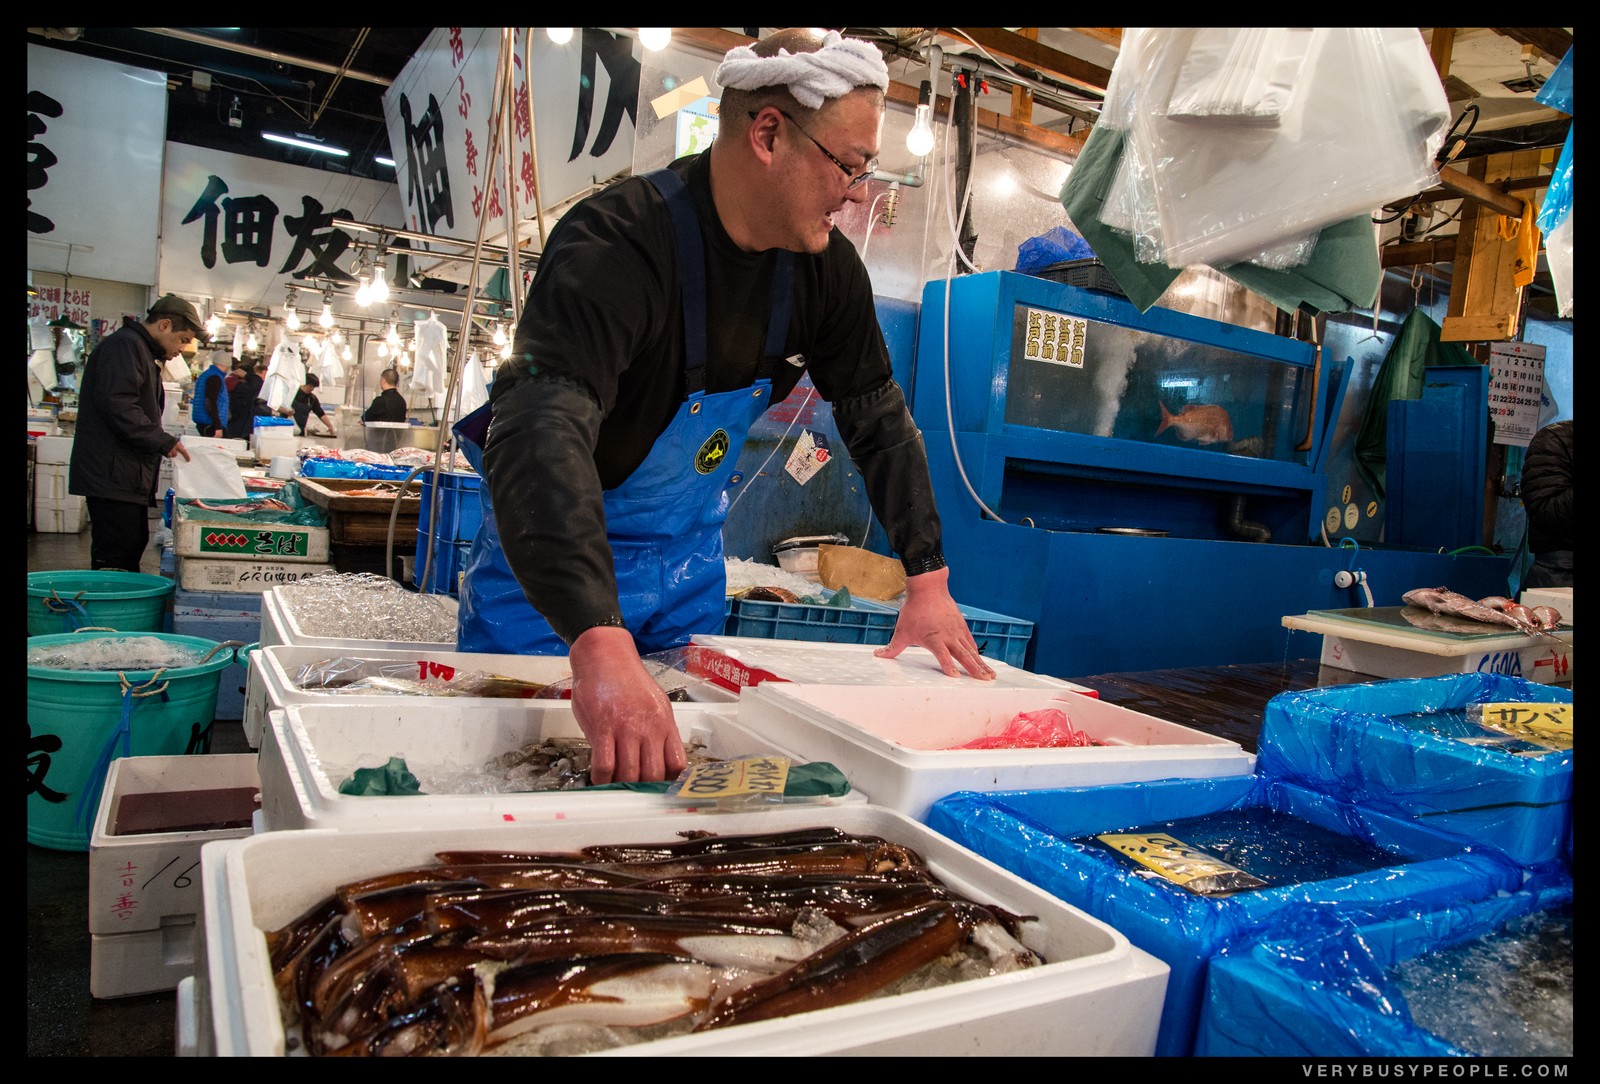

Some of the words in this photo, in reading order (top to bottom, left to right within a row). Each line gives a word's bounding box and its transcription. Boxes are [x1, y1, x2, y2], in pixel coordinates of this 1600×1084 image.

[1026, 311, 1042, 357] 江戸前
[1041, 314, 1057, 360] 江戸前
[1055, 317, 1071, 362] 江戸前
[1070, 320, 1085, 365] 江戸前
[1497, 368, 1502, 376] 7
[1504, 370, 1509, 378] 8
[1520, 372, 1527, 380] 10
[1514, 358, 1519, 366] 2
[1522, 359, 1527, 367] 3
[1530, 360, 1535, 368] 4
[1494, 381, 1501, 389] 14
[1501, 382, 1508, 390] 15
[1510, 383, 1517, 391] 16
[1492, 394, 1499, 402] 21
[1499, 395, 1508, 403] 22
[1507, 396, 1517, 404] 23
[1516, 397, 1524, 405] 24
[1524, 398, 1532, 406] 25
[1506, 409, 1515, 417] 30
[253, 531, 302, 555] さば
[1488, 705, 1567, 728] サバ
